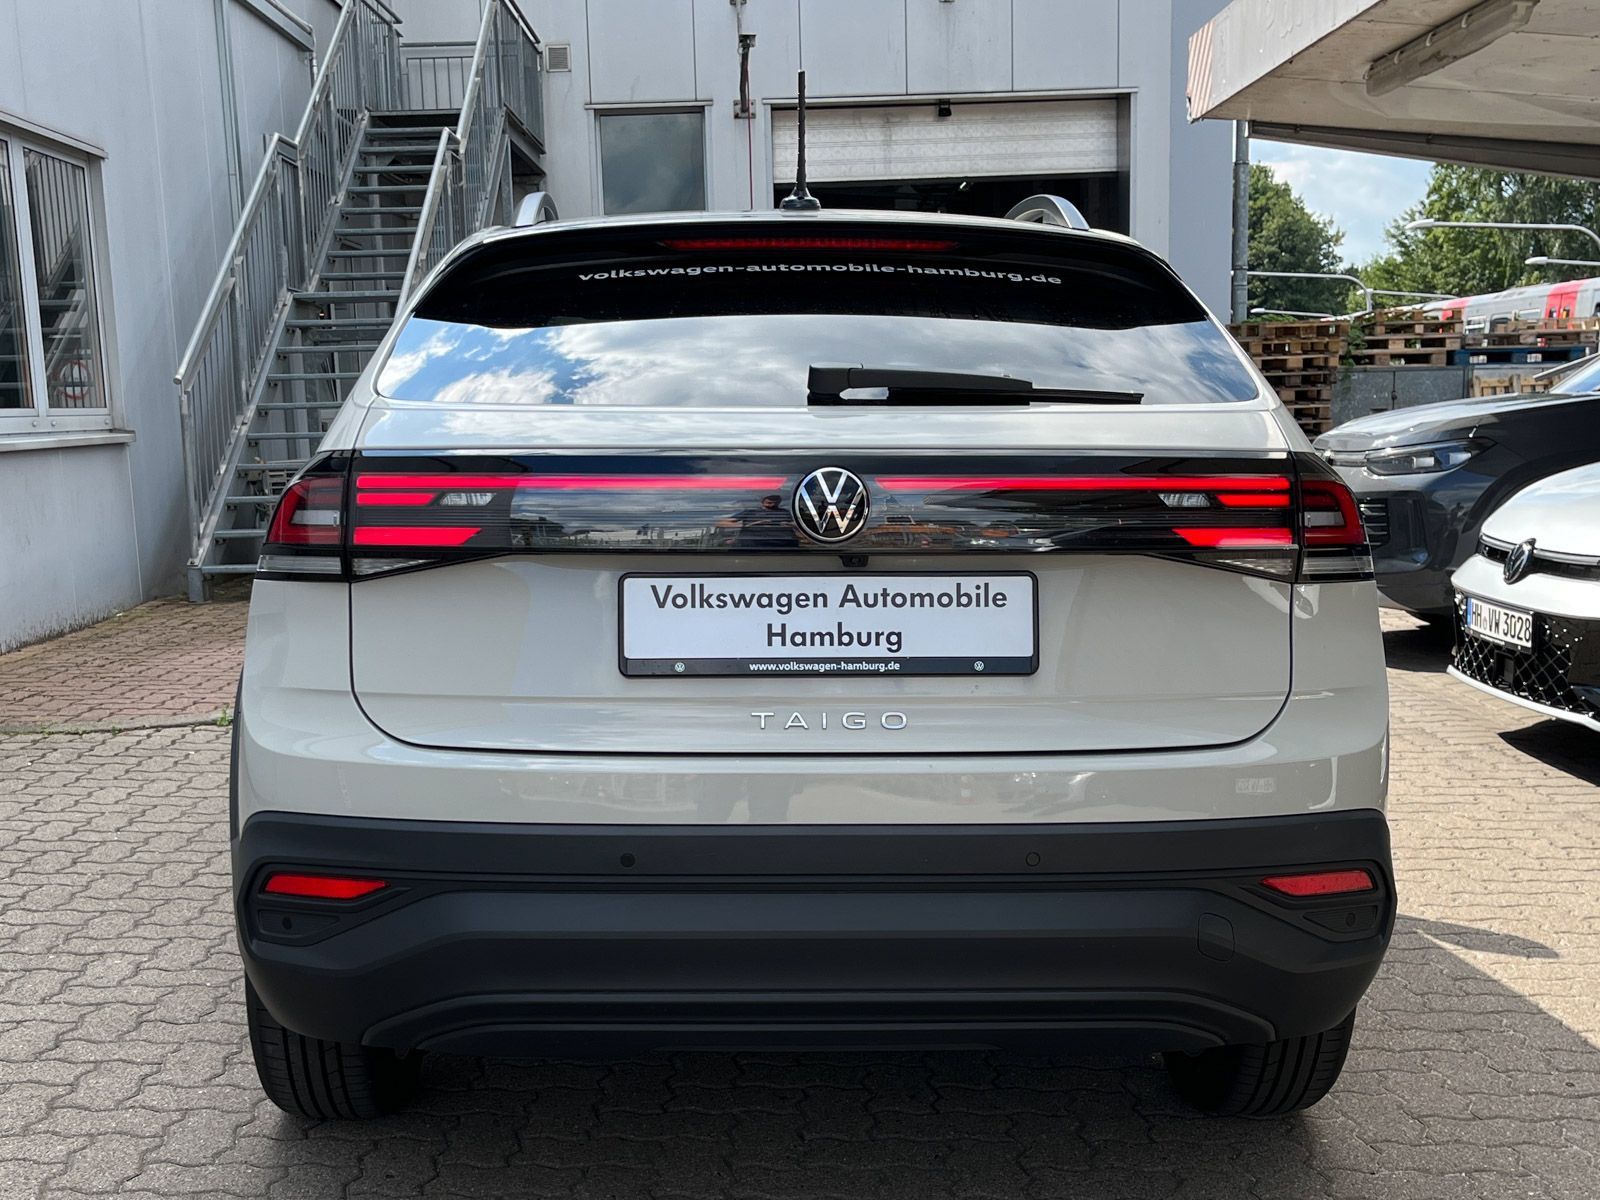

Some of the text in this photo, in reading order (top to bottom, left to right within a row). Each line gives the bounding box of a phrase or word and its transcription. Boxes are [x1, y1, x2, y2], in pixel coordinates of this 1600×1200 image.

[578, 263, 1063, 285] volkswagen-automobile-hamburg.de
[650, 582, 1008, 615] Volkswagen Automobile
[766, 621, 903, 653] Hamburg
[1488, 607, 1500, 634] VW
[1502, 612, 1531, 643] 3028
[749, 661, 901, 673] www.volkswagen-hamburg.de
[750, 711, 908, 731] TAIGO
